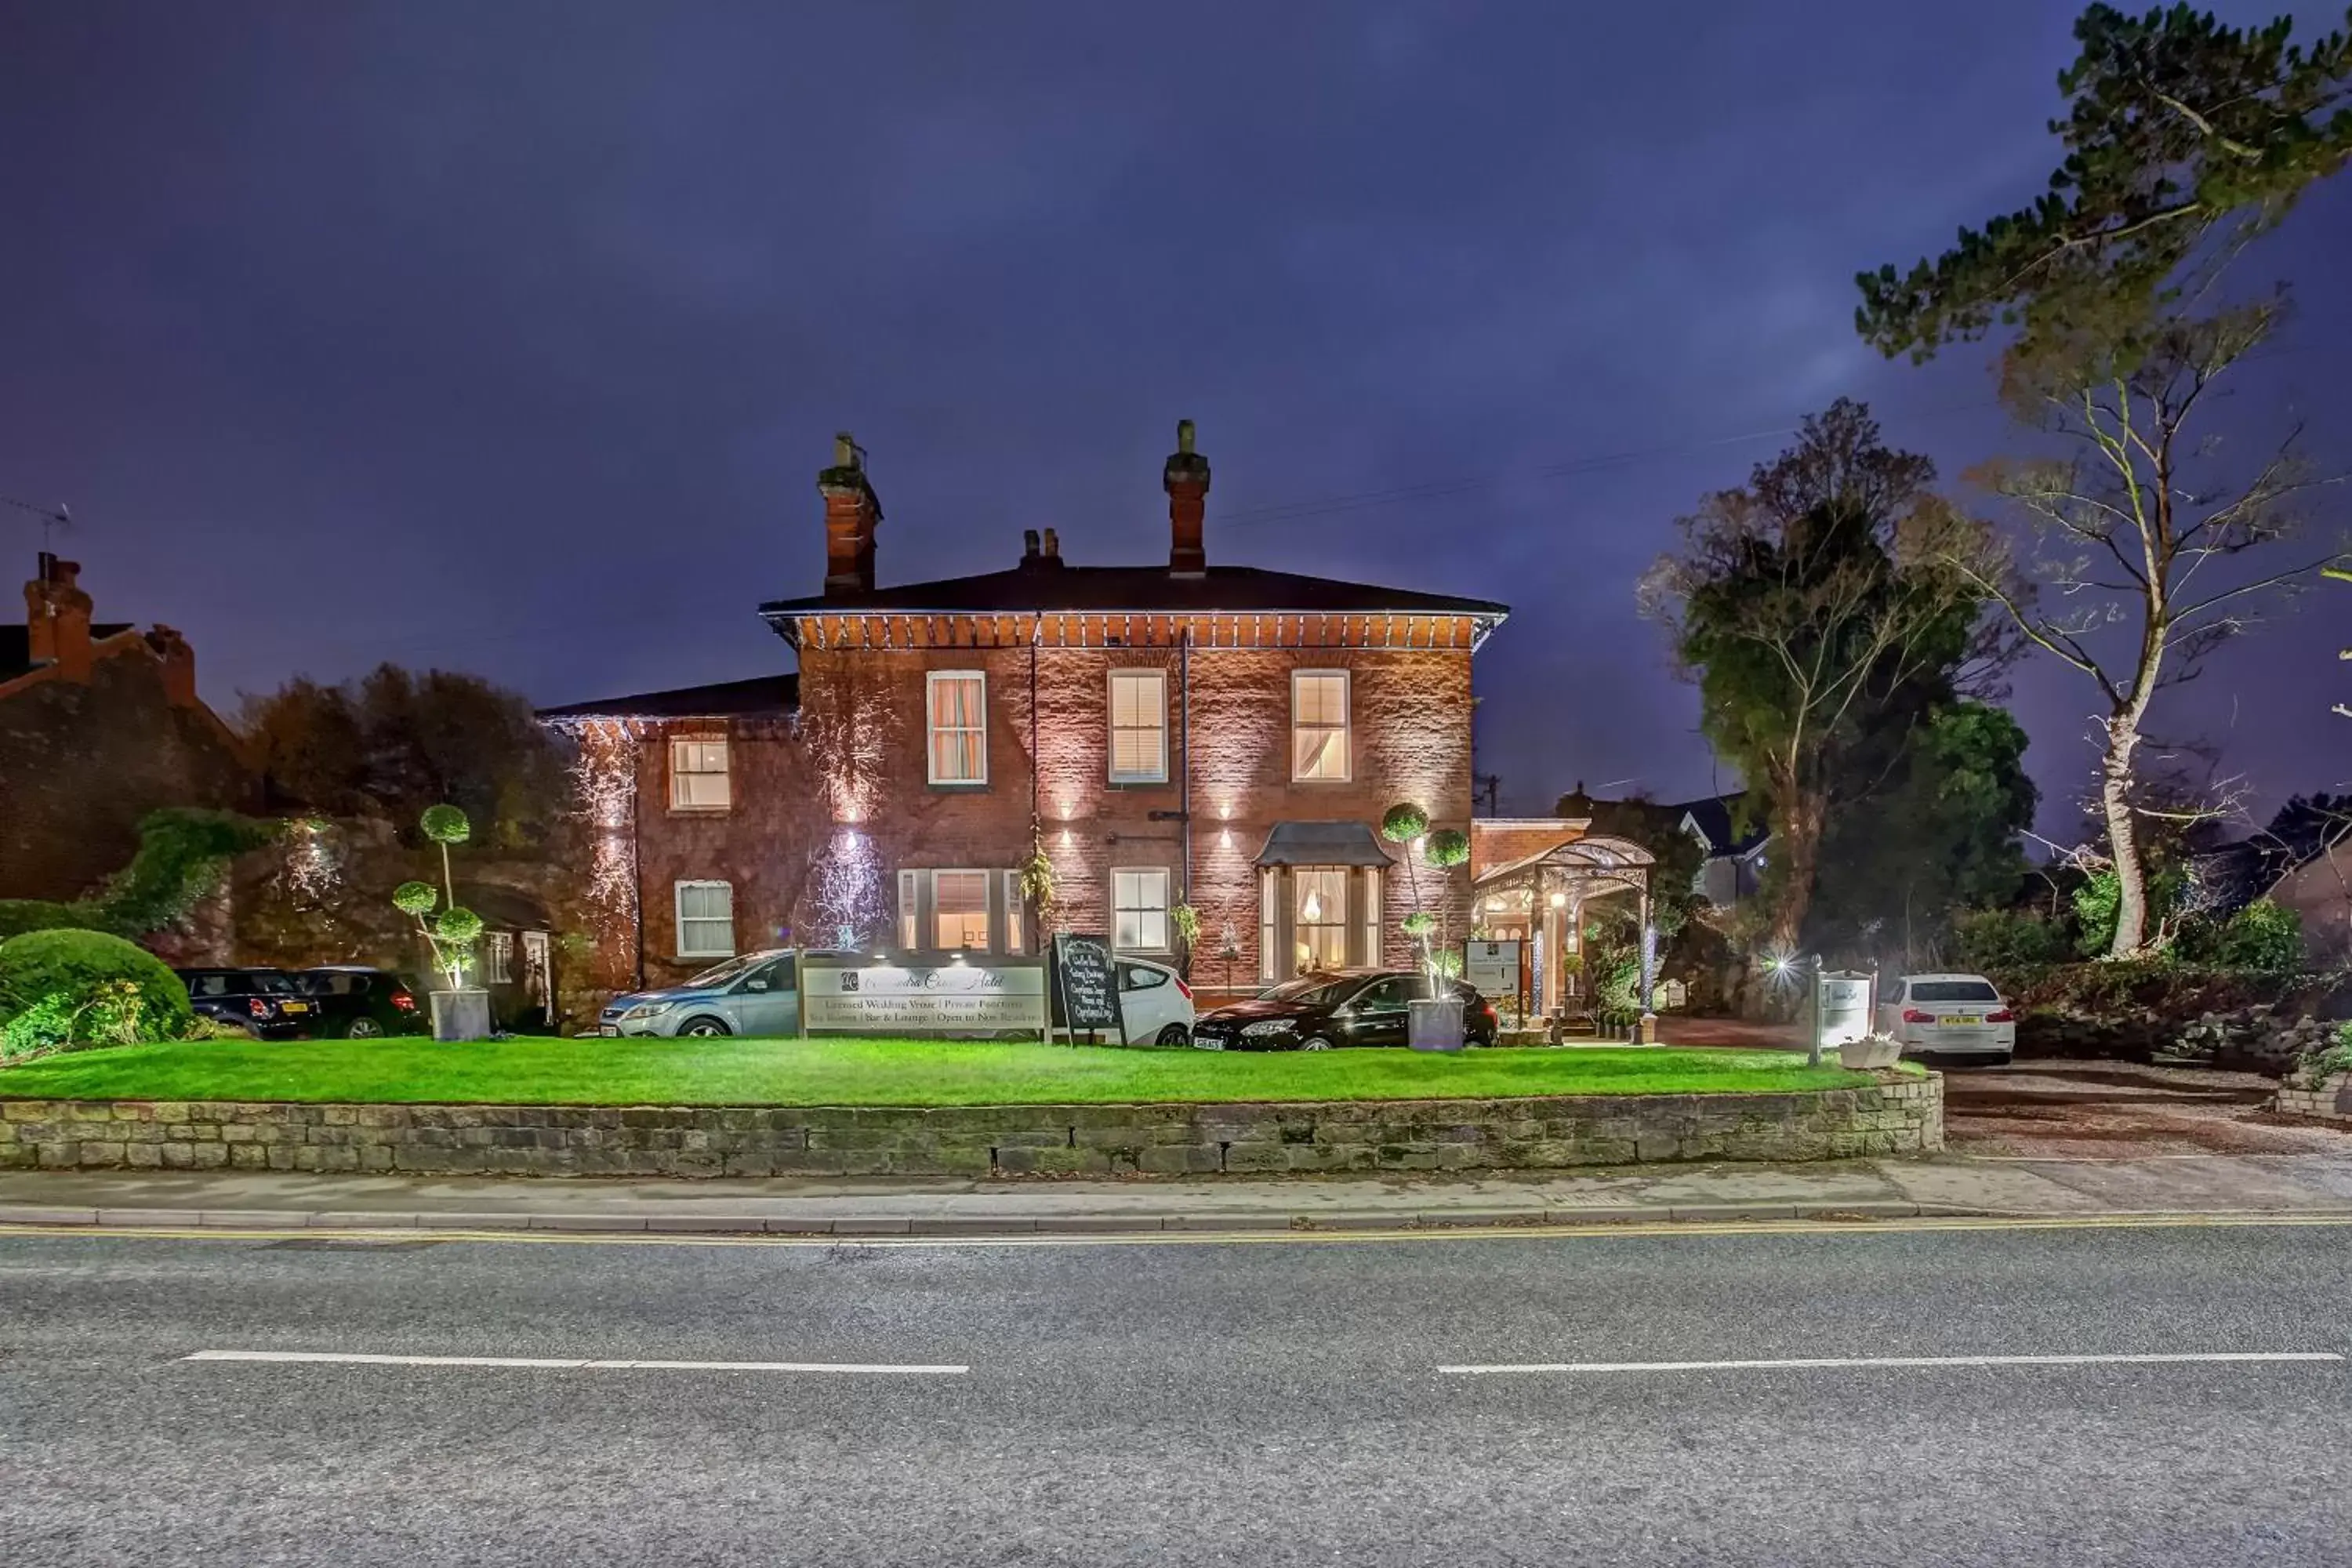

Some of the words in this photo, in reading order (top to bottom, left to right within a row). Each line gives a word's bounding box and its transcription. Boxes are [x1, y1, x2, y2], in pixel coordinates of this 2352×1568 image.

[866, 1000, 907, 1011] Wedding
[909, 1000, 935, 1009] Venue
[895, 1013, 928, 1023] Lounge
[936, 1013, 962, 1024] Open
